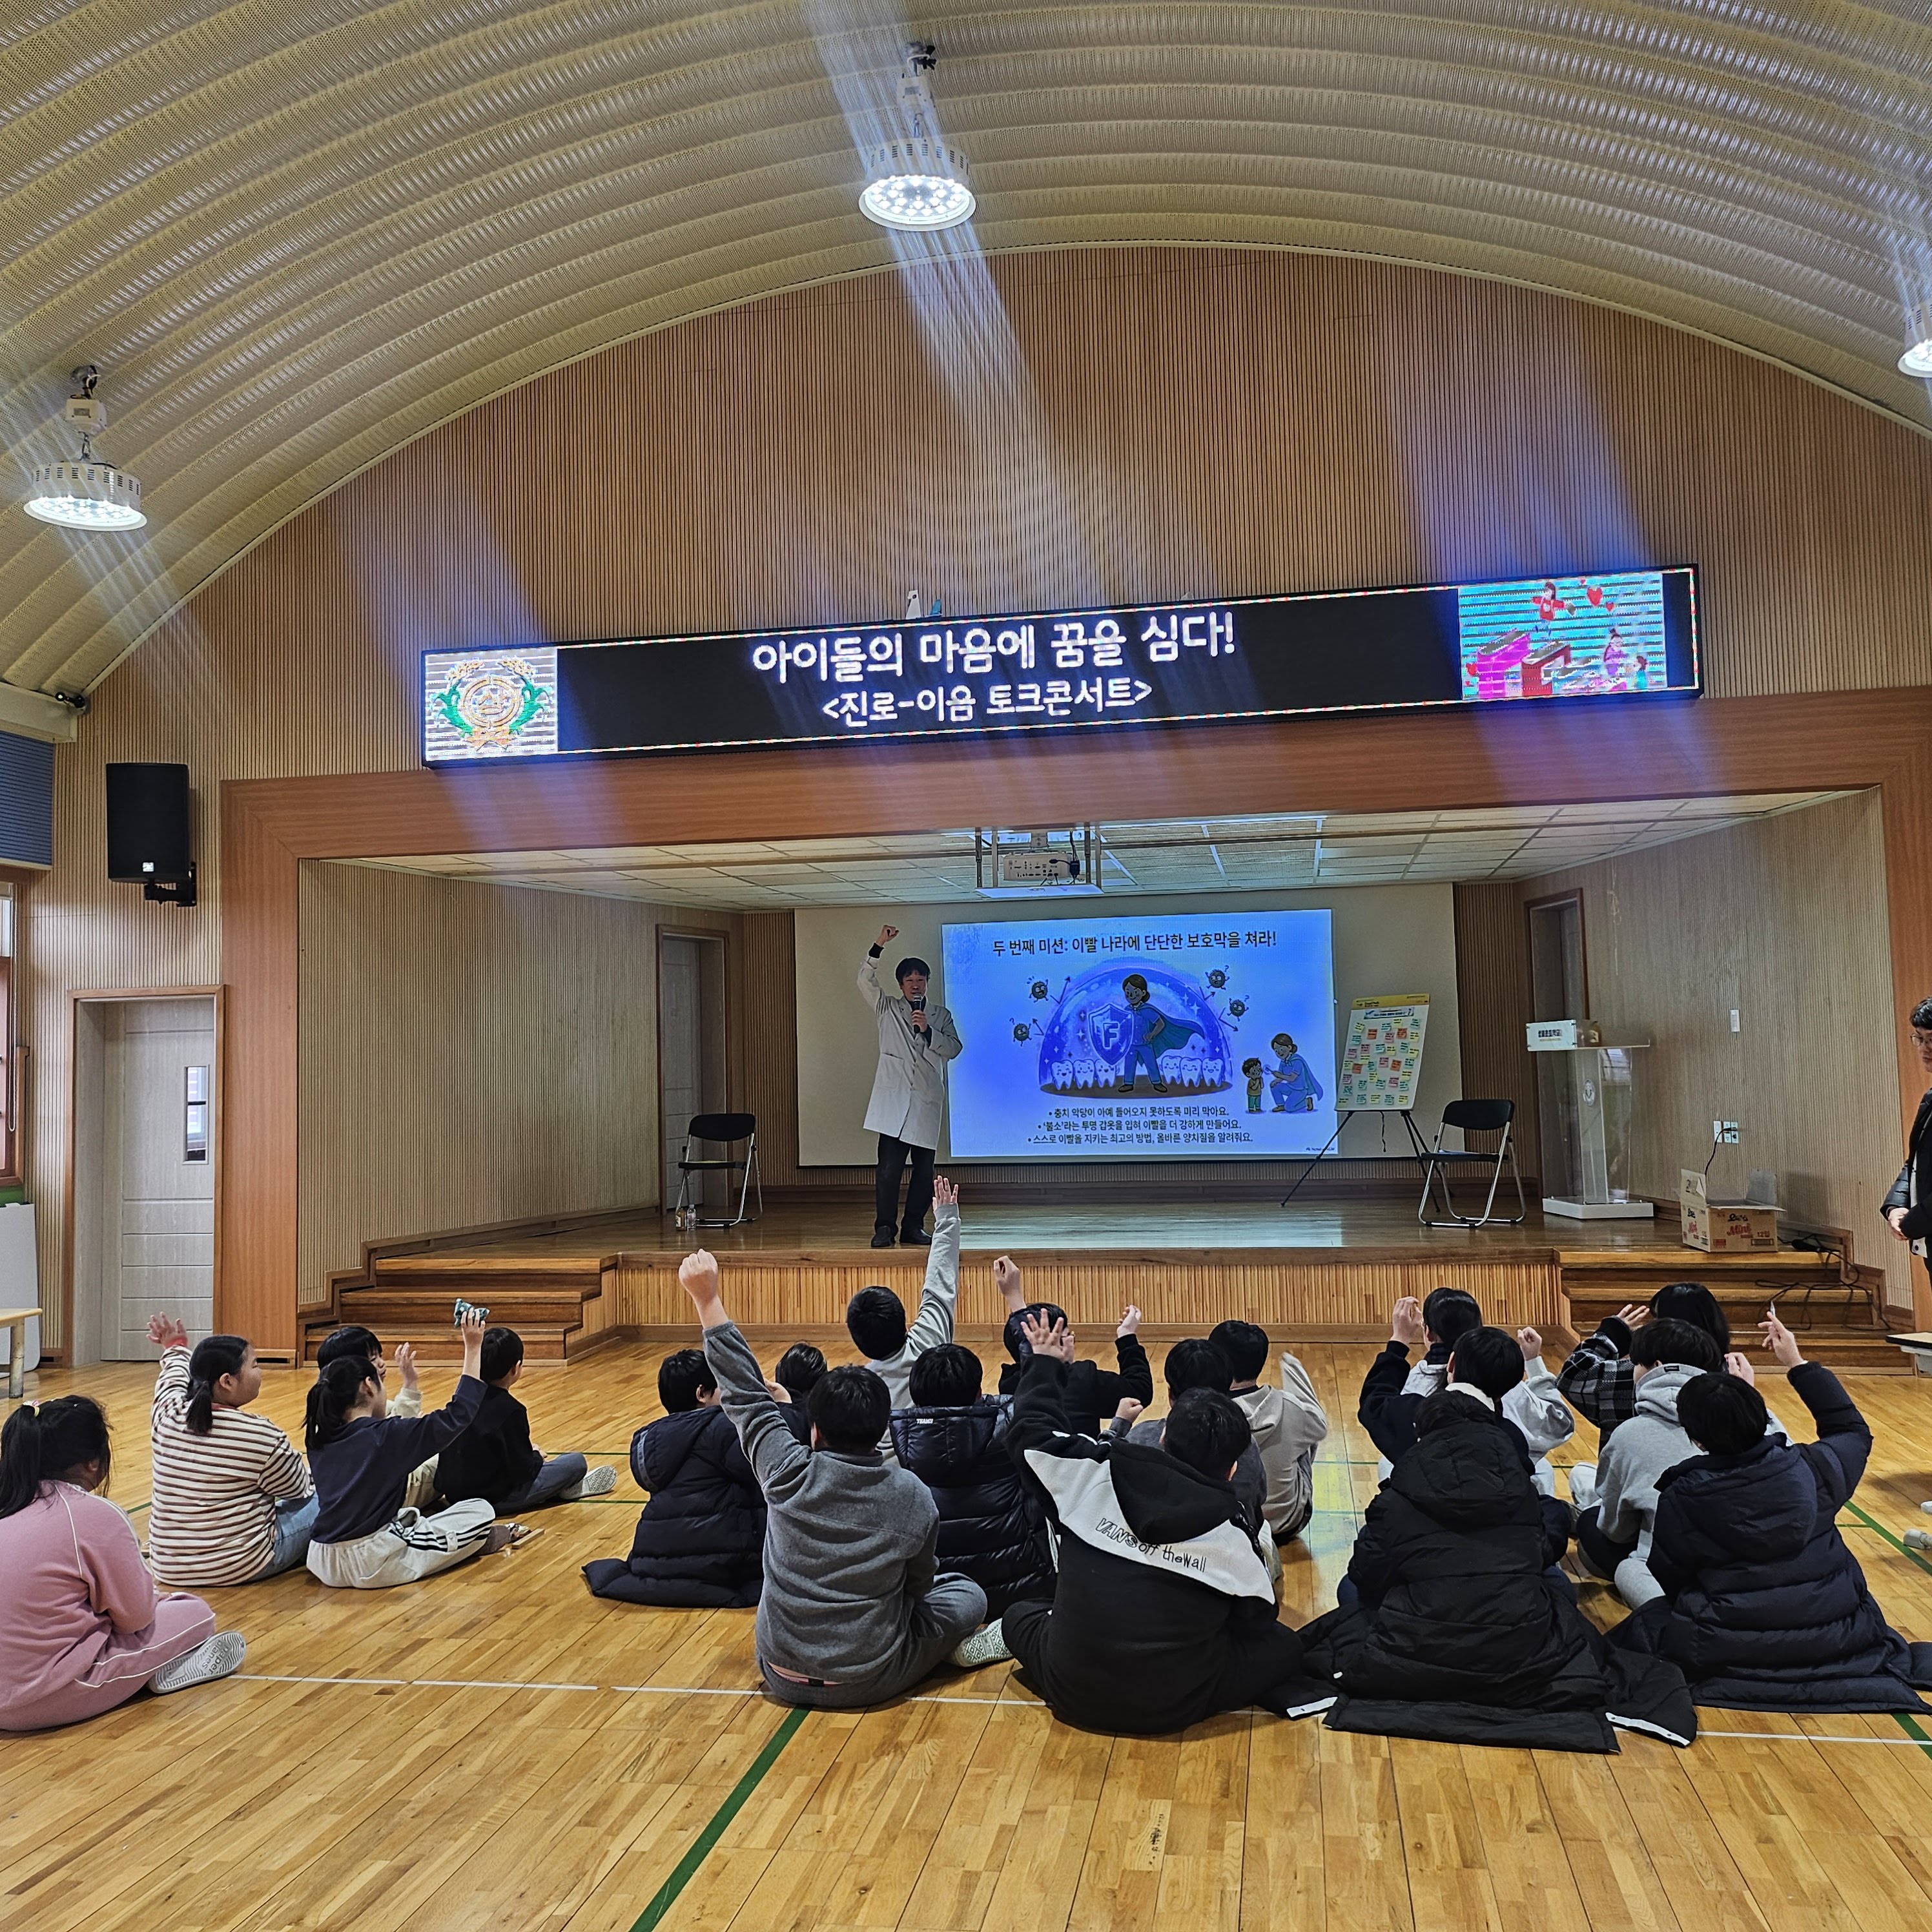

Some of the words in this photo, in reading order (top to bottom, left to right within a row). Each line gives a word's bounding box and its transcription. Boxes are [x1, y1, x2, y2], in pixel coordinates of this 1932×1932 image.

[752, 633, 902, 683] 아이들의
[919, 625, 1034, 673] 마음에
[1050, 619, 1126, 667] 꿈을
[1140, 611, 1234, 662] 심다!
[823, 686, 977, 729] <진로-이음
[987, 677, 1151, 716] 토크콘서트>
[992, 941, 1006, 957] 두
[1009, 939, 1035, 956] 번째
[1039, 938, 1068, 954] 미션:
[1072, 936, 1098, 953] 이빨
[1102, 934, 1140, 952] 나라에
[1144, 933, 1184, 951] 단단한
[1187, 931, 1241, 949] 보호막을
[1244, 930, 1277, 947] 쳐라!
[1102, 1022, 1120, 1049] F
[1054, 1108, 1069, 1118] 충치
[1071, 1107, 1095, 1118] 악당이
[1097, 1107, 1113, 1118] 아예
[1115, 1107, 1147, 1118] 들어오지
[1149, 1106, 1182, 1117] 못하도록
[1184, 1105, 1200, 1117] 미리
[1202, 1105, 1229, 1117] 막아요.
[1082, 1120, 1097, 1131] 투명
[1099, 1120, 1123, 1131] 갑옷을
[1125, 1120, 1141, 1131] 입혀
[1143, 1119, 1167, 1130] 이빨을
[1169, 1119, 1177, 1130] 더
[1179, 1119, 1204, 1130] 강하게
[1206, 1119, 1242, 1130] 만들어요.
[1033, 1135, 1057, 1144] 스스로
[1058, 1134, 1082, 1144] 이빨을
[1084, 1133, 1109, 1144] 지키는
[1110, 1133, 1134, 1144] 최고의
[1136, 1133, 1155, 1144] 방법,
[1156, 1133, 1181, 1144] 올바른
[1183, 1132, 1216, 1143] 양치질을
[1217, 1132, 1253, 1143] 알려줘요.
[1095, 1518, 1138, 1549] VANS
[1138, 1544, 1161, 1557] off
